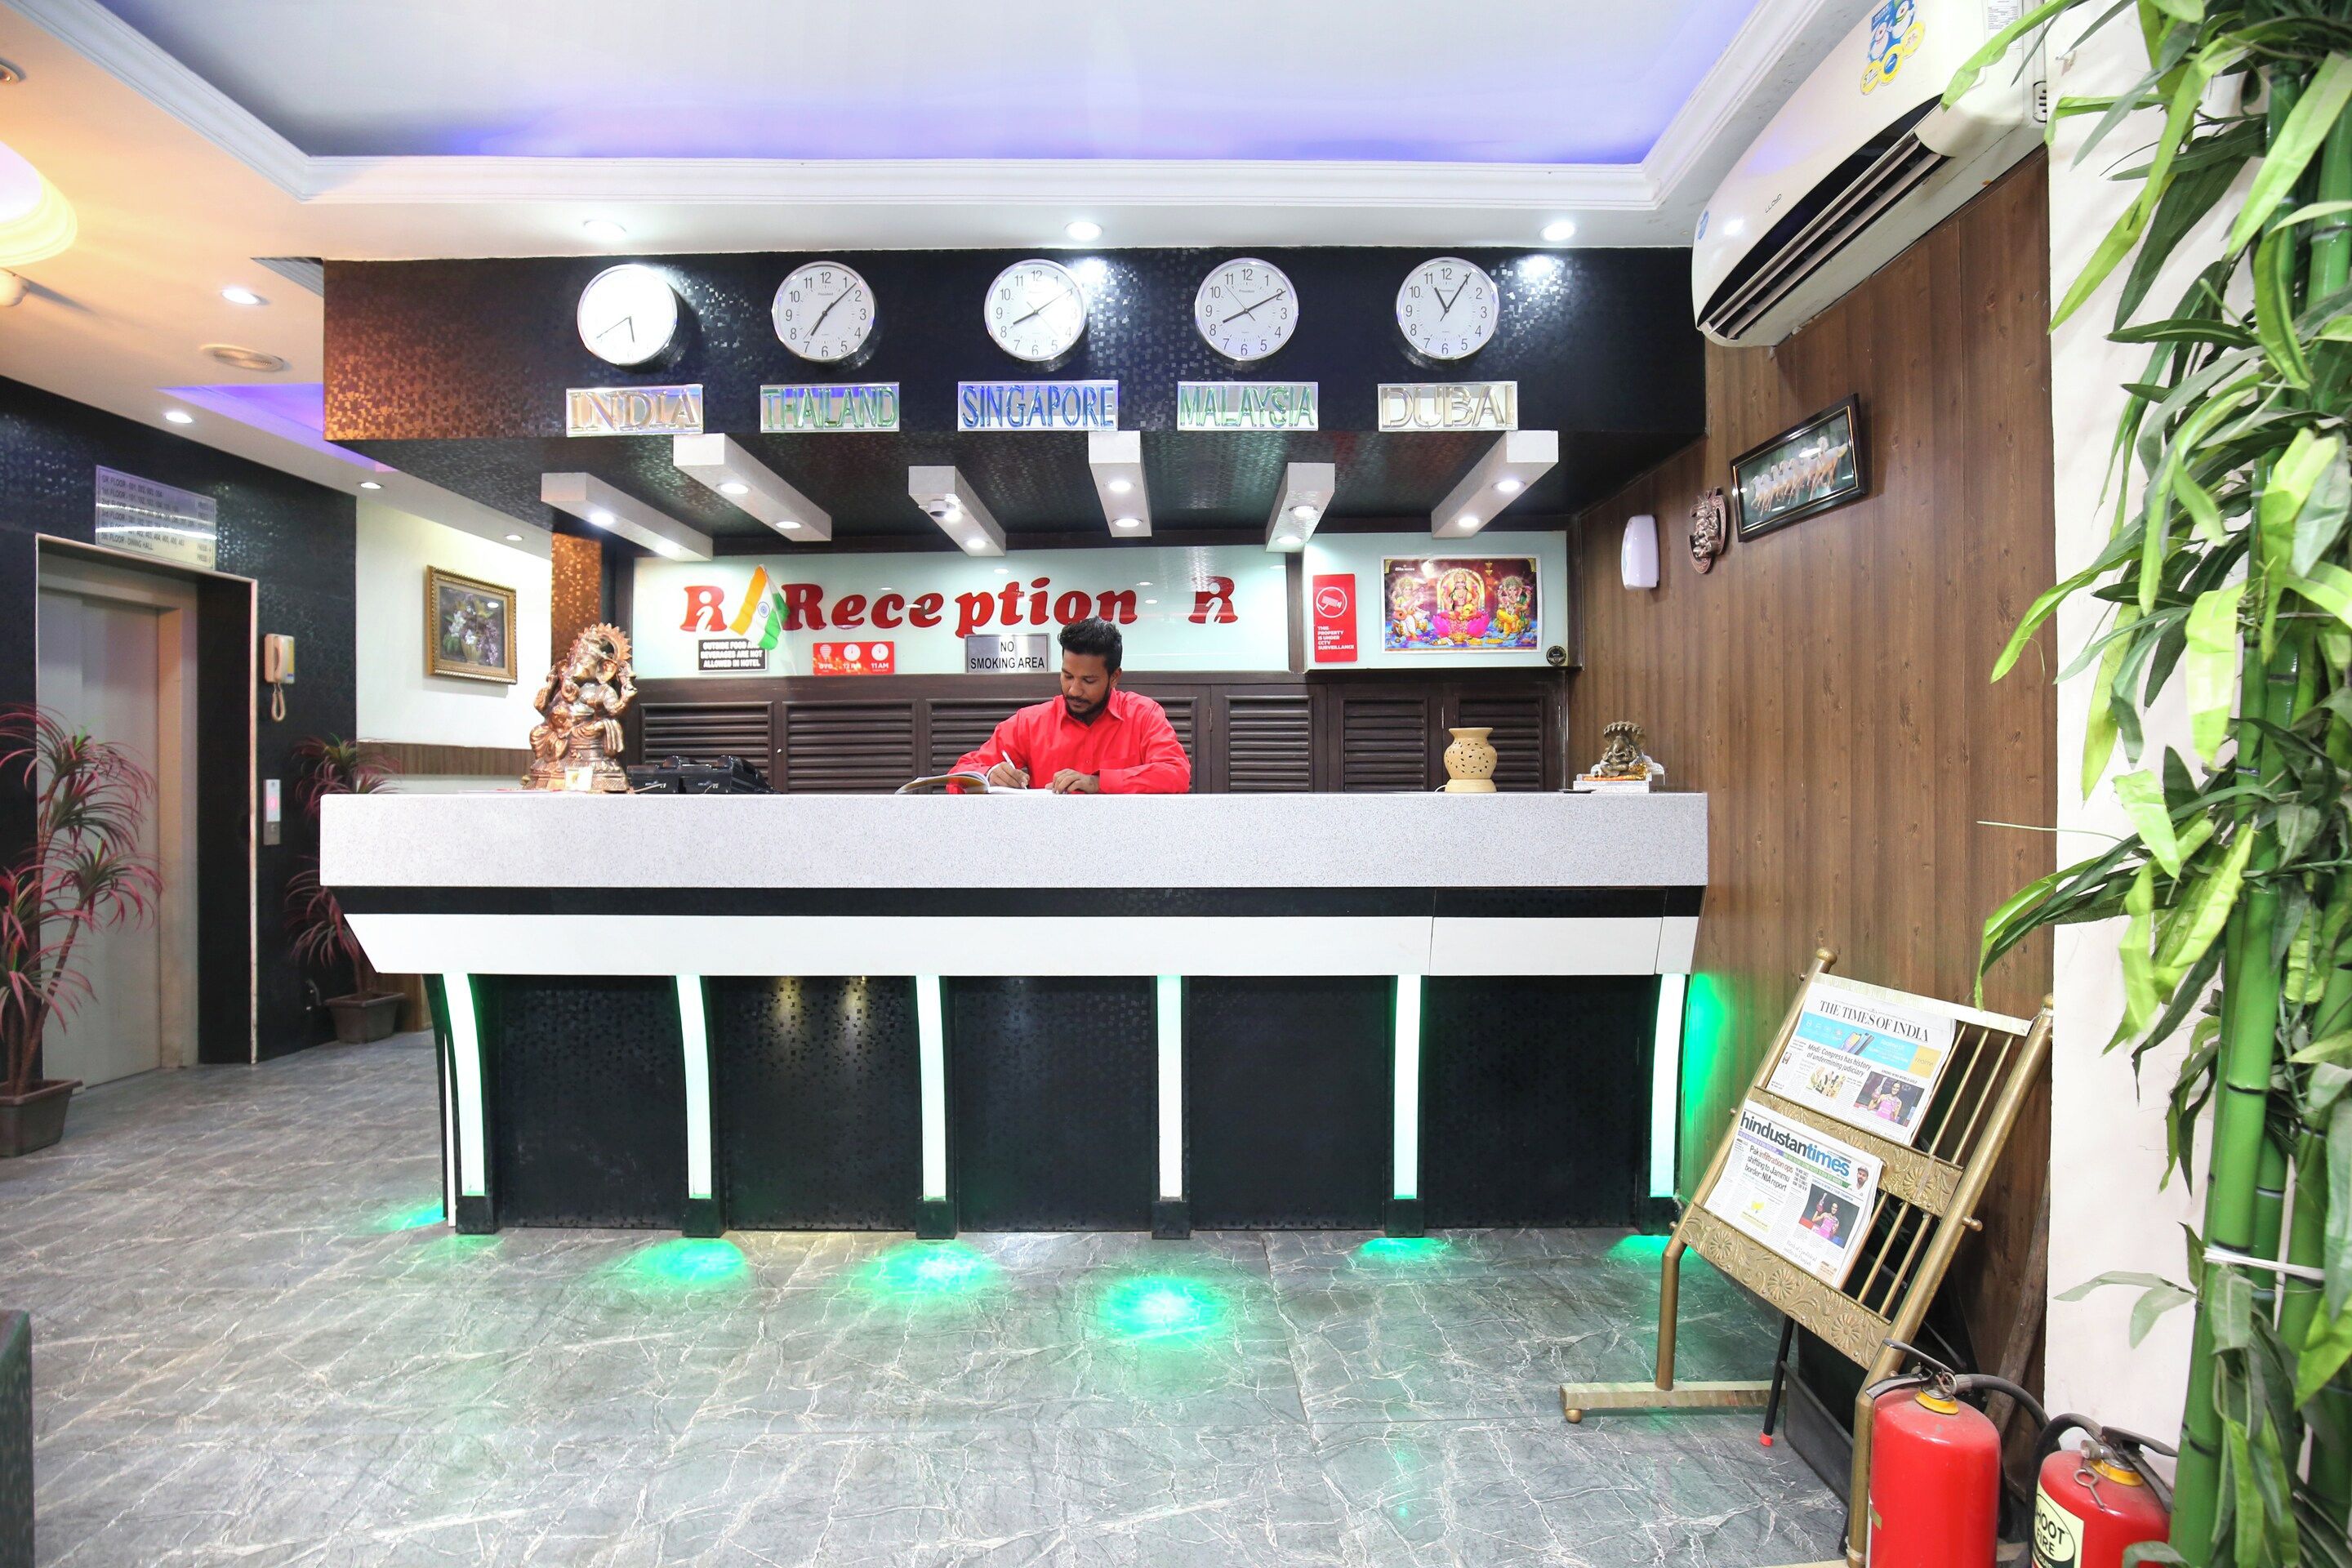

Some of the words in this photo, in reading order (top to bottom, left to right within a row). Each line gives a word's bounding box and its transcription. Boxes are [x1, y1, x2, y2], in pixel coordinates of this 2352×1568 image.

[821, 272, 831, 283] 12
[1031, 270, 1042, 281] 12
[1225, 274, 1233, 284] 11
[1242, 269, 1253, 280] 12
[1425, 273, 1432, 284] 11
[1441, 268, 1452, 279] 12
[804, 277, 813, 288] 11
[844, 277, 847, 287] 1
[1014, 275, 1022, 286] 11
[1054, 276, 1058, 285] 1
[1265, 274, 1268, 286] 1
[790, 291, 800, 302] 10
[855, 290, 862, 301] 2
[1000, 288, 1010, 301] 10
[1210, 287, 1220, 298] 10
[1276, 288, 1283, 301] 2
[1410, 286, 1420, 298] 10
[1476, 287, 1482, 299] 2
[786, 310, 792, 321] 9
[860, 309, 866, 320] 3
[996, 307, 1002, 319] 9
[1206, 305, 1212, 317] 9
[1281, 308, 1287, 319] 3
[1406, 305, 1412, 317] 9
[1481, 306, 1486, 318] 3
[791, 327, 796, 340] 8
[854, 327, 861, 338] 4
[1000, 326, 1007, 338] 8
[1066, 327, 1071, 337] 4
[1209, 324, 1216, 336] 8
[1275, 327, 1281, 337] 4
[1410, 324, 1416, 336] 8
[1475, 325, 1481, 336] 4
[804, 341, 809, 353] 7
[841, 341, 848, 352] 5
[1014, 340, 1020, 351] 7
[1052, 340, 1058, 351] 5
[1223, 338, 1229, 350] 7
[1260, 340, 1267, 351] 5
[1423, 338, 1430, 348] 7
[1442, 343, 1448, 354] 6
[1461, 339, 1468, 350] 5
[822, 346, 828, 357] 6
[1032, 345, 1038, 355] 6
[1241, 344, 1247, 355] 6
[569, 390, 700, 430] INDIA
[762, 387, 897, 427] THAILAND
[962, 385, 1114, 427] SINGAPORE
[1180, 385, 1314, 427] MALAYSIA
[1382, 385, 1513, 428] DUBAI
[109, 533, 124, 543] FLOOR
[781, 577, 1138, 639] Reception
[730, 641, 746, 649] FOOD
[1000, 641, 1014, 652] NO
[701, 650, 736, 659] BEVERAGES
[737, 650, 749, 658] ARE
[750, 649, 763, 657] NOT
[703, 659, 733, 668] ALLOWED
[733, 659, 740, 667] IN
[741, 658, 761, 667] HOTEL
[970, 657, 1015, 670] SMOKING
[1018, 657, 1045, 669] AREA
[1820, 1000, 1841, 1016] THE
[1842, 1007, 1875, 1026] TIMES
[1877, 1018, 1893, 1030] OF
[1893, 1021, 1928, 1042] INDIA
[1822, 1049, 1843, 1061] Congress
[1844, 1055, 1853, 1064] has
[1853, 1058, 1872, 1071] history
[1813, 1055, 1842, 1070] undermining
[1842, 1064, 1864, 1077] judiciary
[1750, 1145, 1759, 1156] Pak
[1759, 1150, 1784, 1168] infiltration
[1784, 1165, 1793, 1174] ops
[1748, 1156, 1765, 1170] shifting
[1771, 1167, 1789, 1182] Jammu
[1762, 1172, 1771, 1183] NIA
[1771, 1179, 1787, 1192] report
[2037, 1527, 2056, 1557] FIRE
